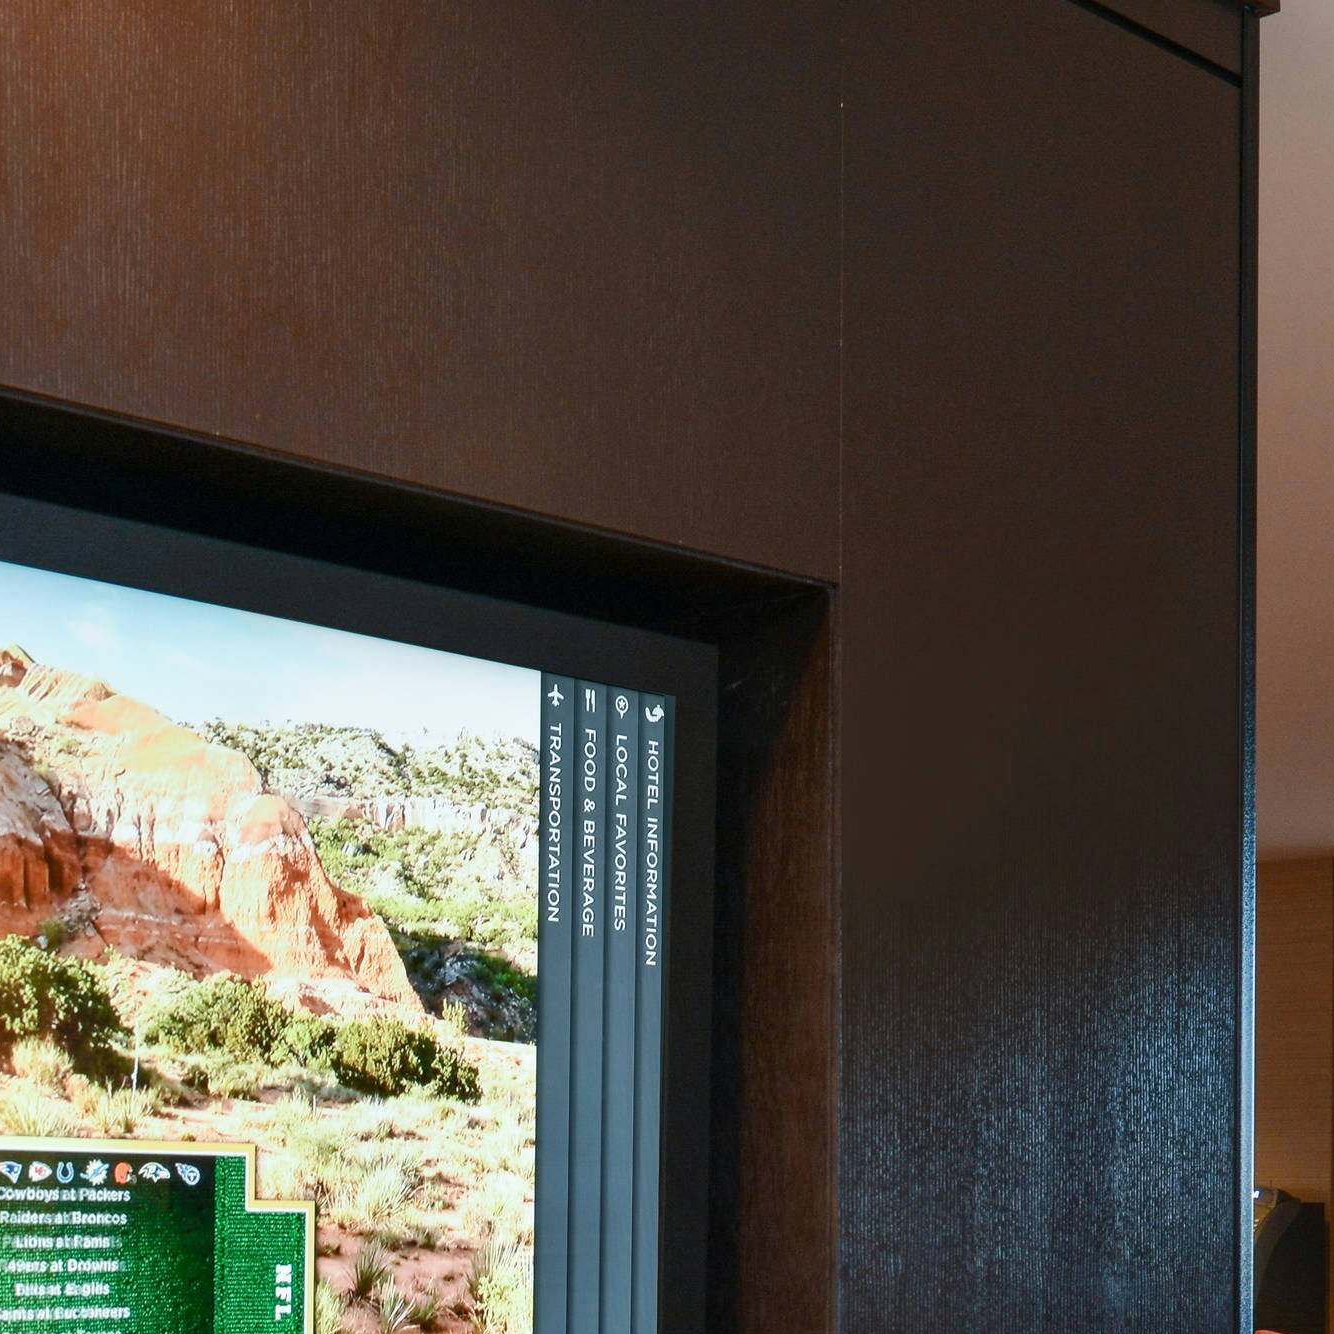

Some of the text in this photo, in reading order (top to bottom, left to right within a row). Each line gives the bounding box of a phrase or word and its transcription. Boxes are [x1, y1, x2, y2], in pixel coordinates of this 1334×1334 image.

[547, 722, 562, 922] TRANSPORTATION
[582, 728, 596, 937] FOOD & BEVERAGE
[614, 734, 628, 931] LOCAL FAVORITES
[646, 740, 659, 966] HOTEL INFORMATION
[0, 1211, 53, 1225] Raiders
[72, 1210, 128, 1225] Broncos
[61, 1187, 77, 1201] at
[79, 1186, 131, 1201] Packers
[275, 1263, 292, 1321] NFL
